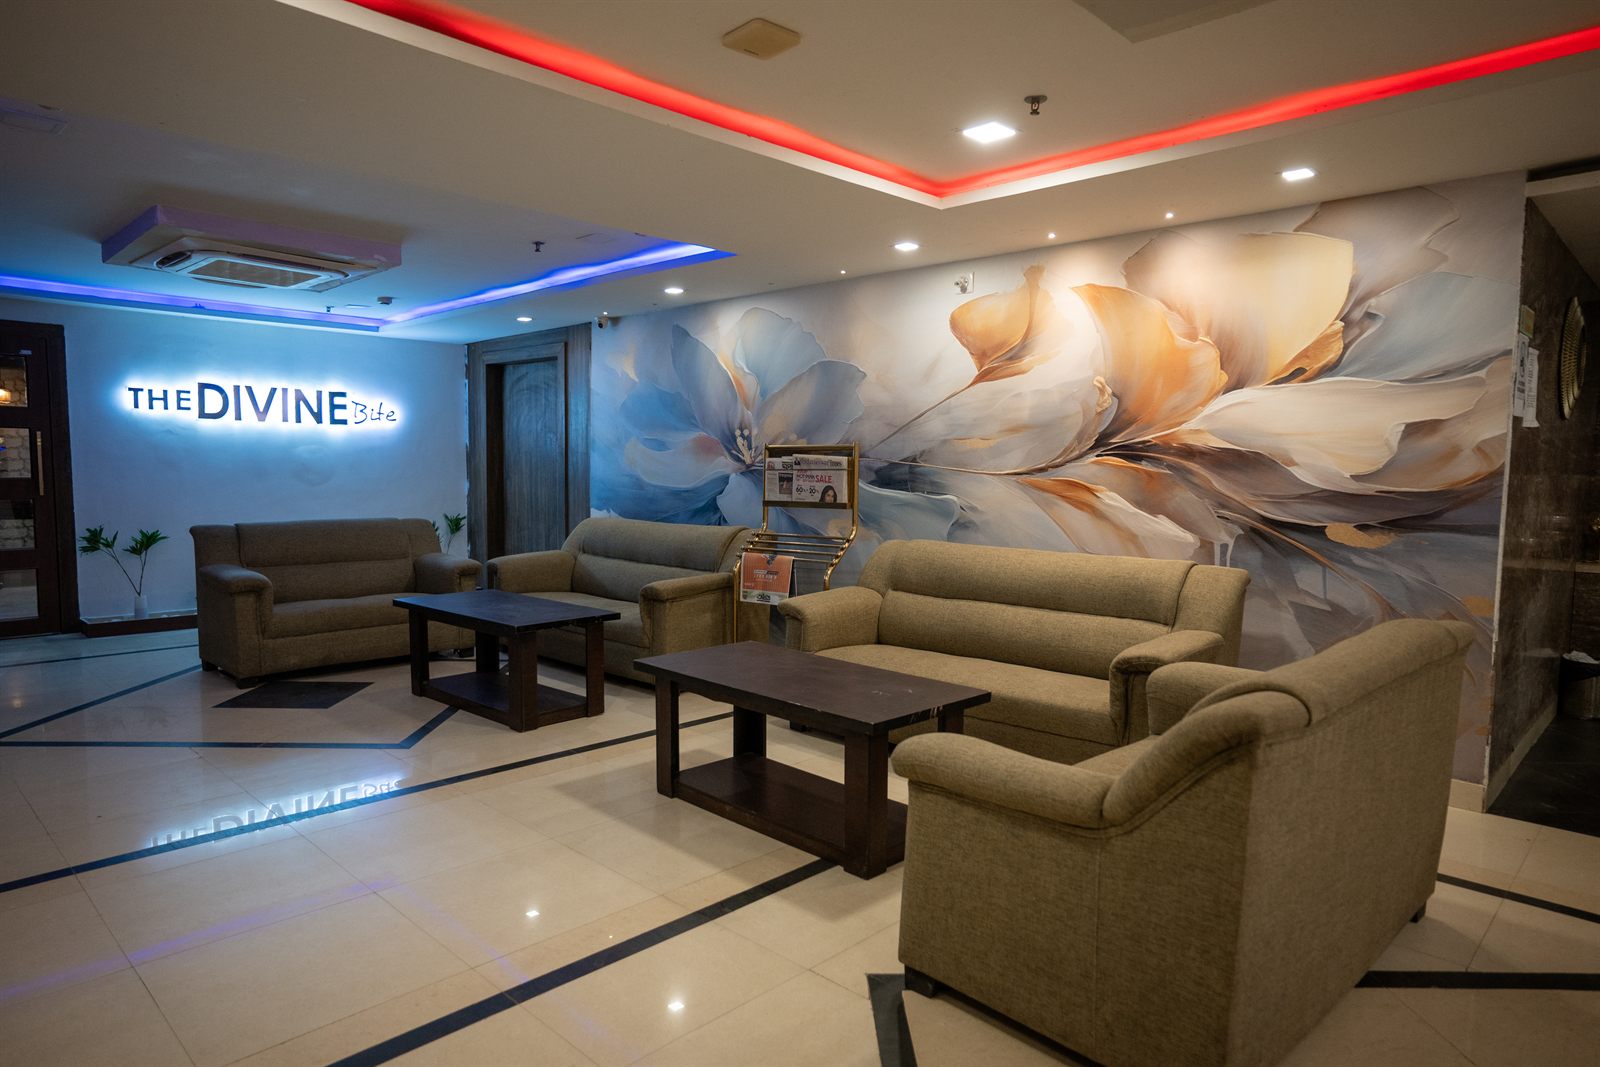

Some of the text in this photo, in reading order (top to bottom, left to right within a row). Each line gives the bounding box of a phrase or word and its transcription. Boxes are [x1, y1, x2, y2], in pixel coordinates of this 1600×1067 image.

[128, 382, 397, 425] THE DIVINE Bite
[815, 474, 832, 483] SALE
